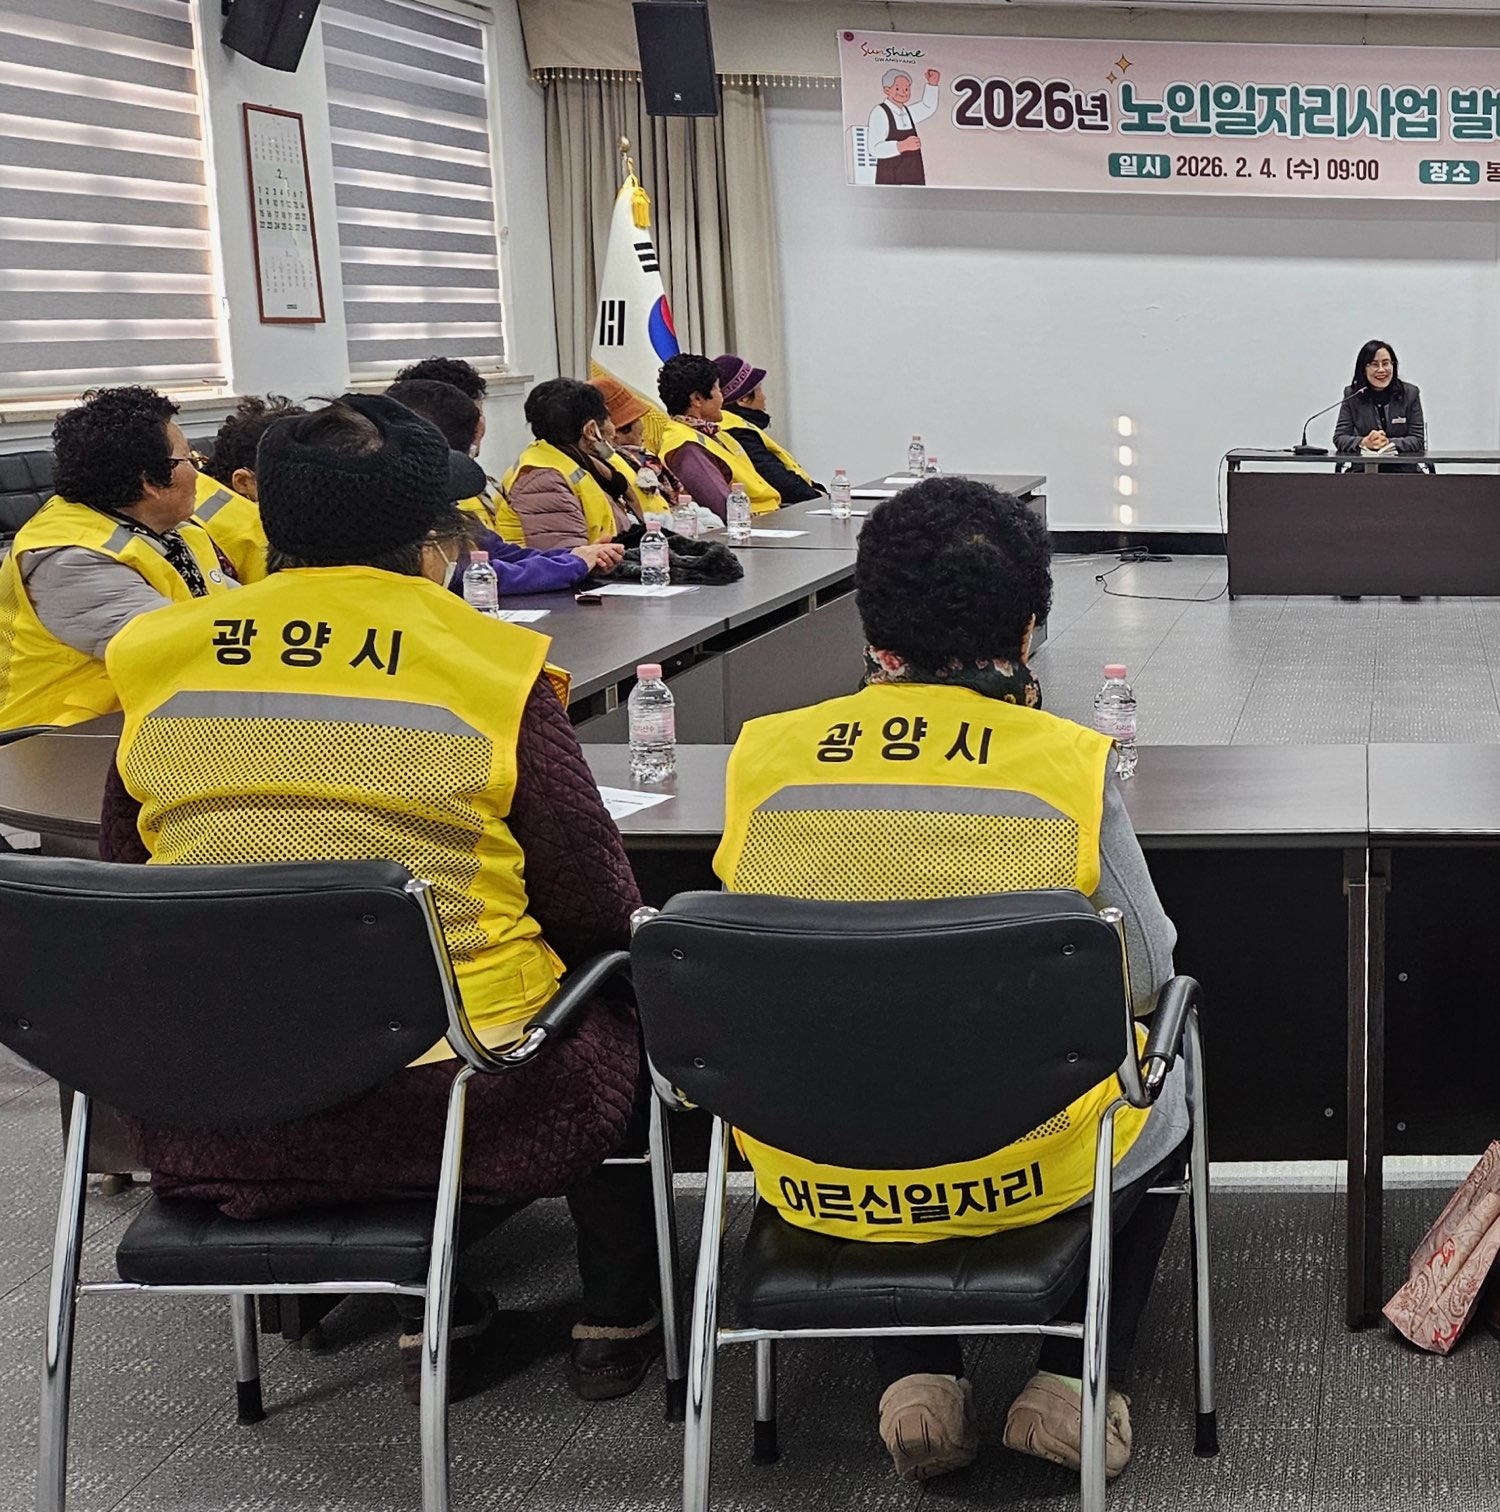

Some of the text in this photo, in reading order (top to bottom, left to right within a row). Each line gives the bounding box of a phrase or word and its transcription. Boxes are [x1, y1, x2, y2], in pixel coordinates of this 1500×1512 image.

[860, 41, 925, 58] Sunshine
[954, 80, 1108, 131] 2026년
[1121, 84, 1439, 139] 노인일자리사업
[1118, 153, 1162, 178] 일시
[1176, 155, 1228, 178] 2026.
[1235, 157, 1253, 178] 2.
[1259, 157, 1277, 179] 4.
[1326, 158, 1379, 181] 09:00
[1429, 161, 1472, 184] 장소
[211, 618, 404, 676] 광양시
[815, 716, 993, 765] 광양시
[778, 1161, 1045, 1225] 어르신일자리
